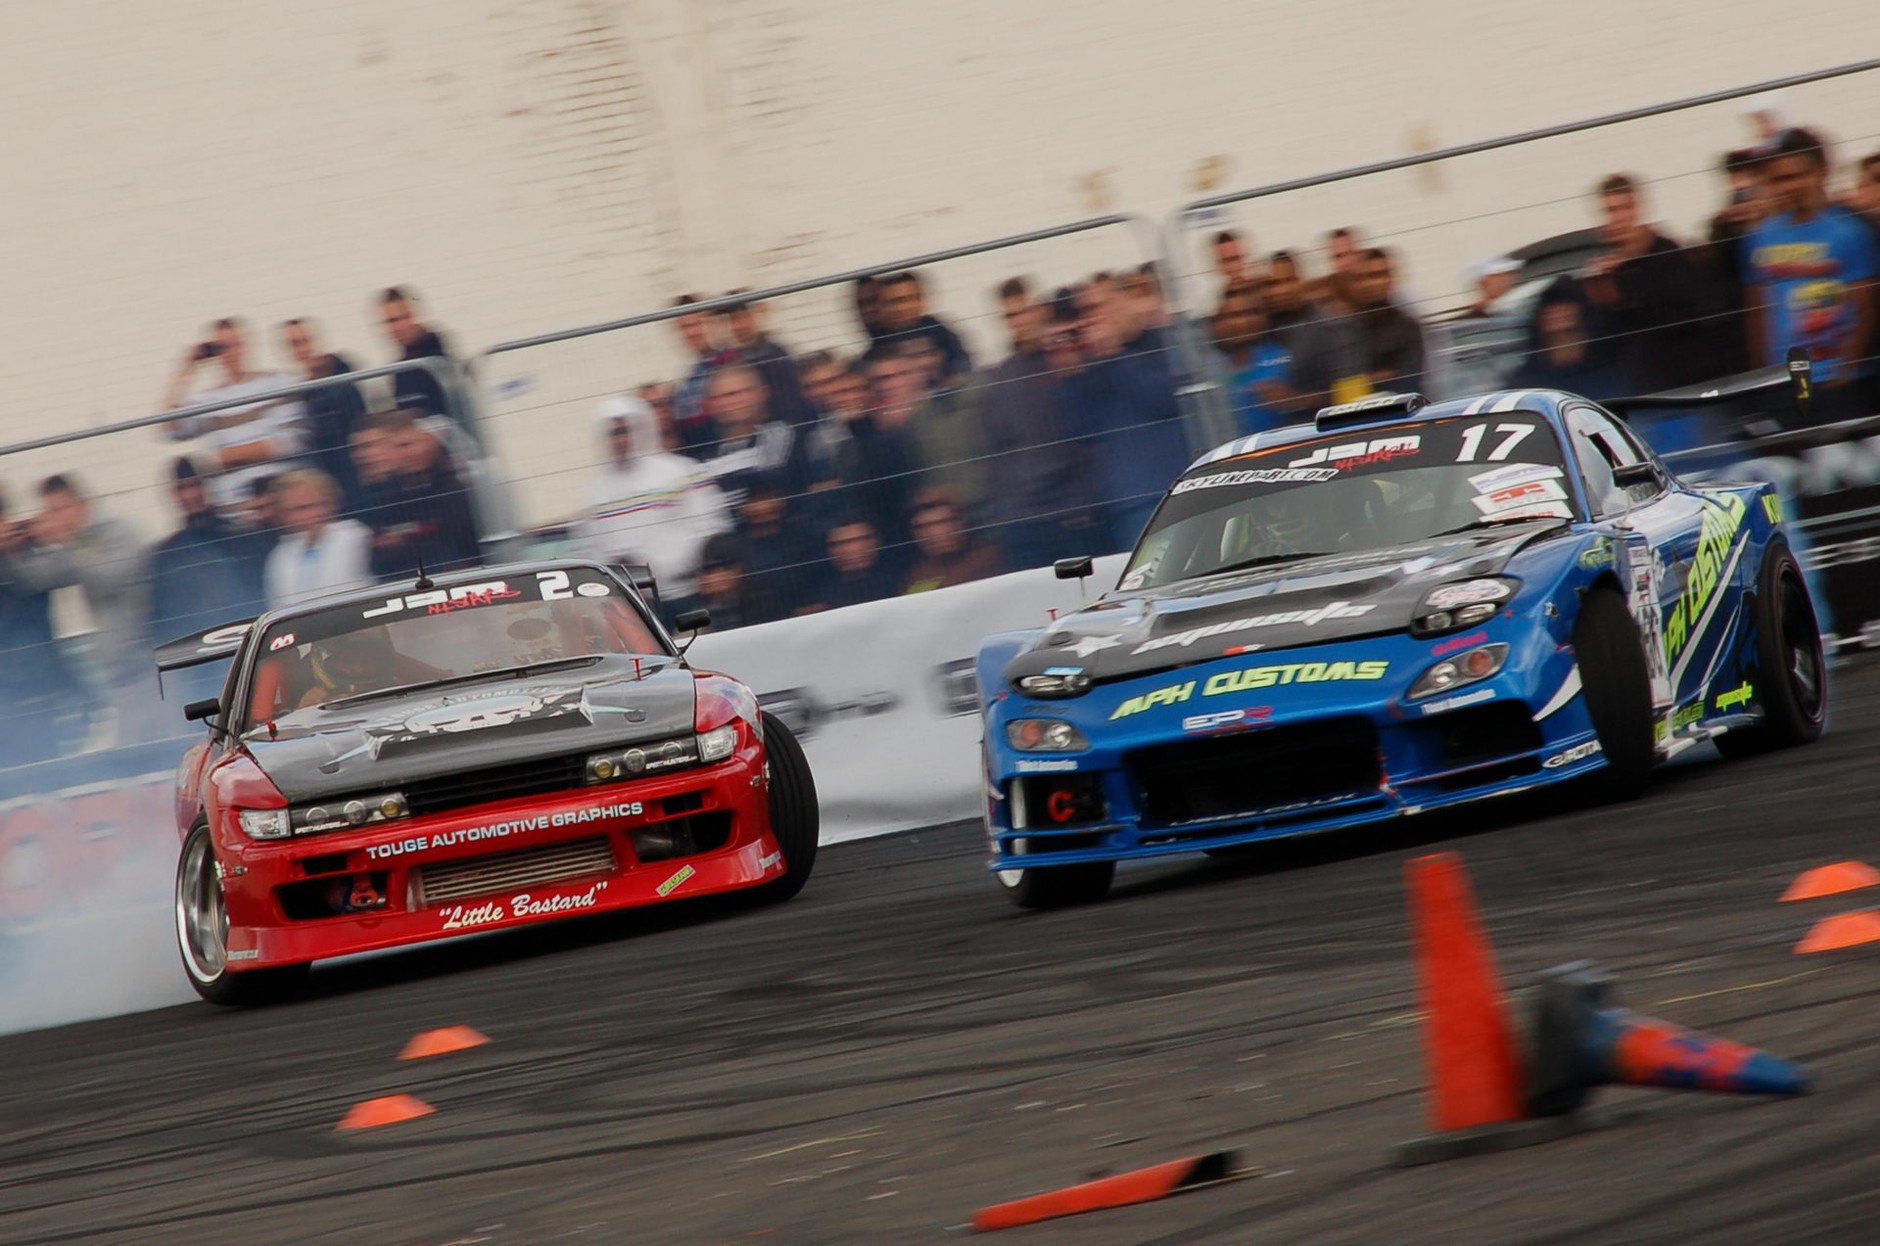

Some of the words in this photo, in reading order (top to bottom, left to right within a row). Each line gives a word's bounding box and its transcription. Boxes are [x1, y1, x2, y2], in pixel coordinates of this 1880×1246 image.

[1456, 423, 1536, 462] 17
[535, 570, 574, 601] 2
[1109, 680, 1197, 721] MPH
[1202, 660, 1390, 696] CUSTOMS
[366, 836, 428, 860] TOUGE
[431, 815, 549, 848] AUTOMOTIVE
[552, 801, 644, 828] GRAPHICS
